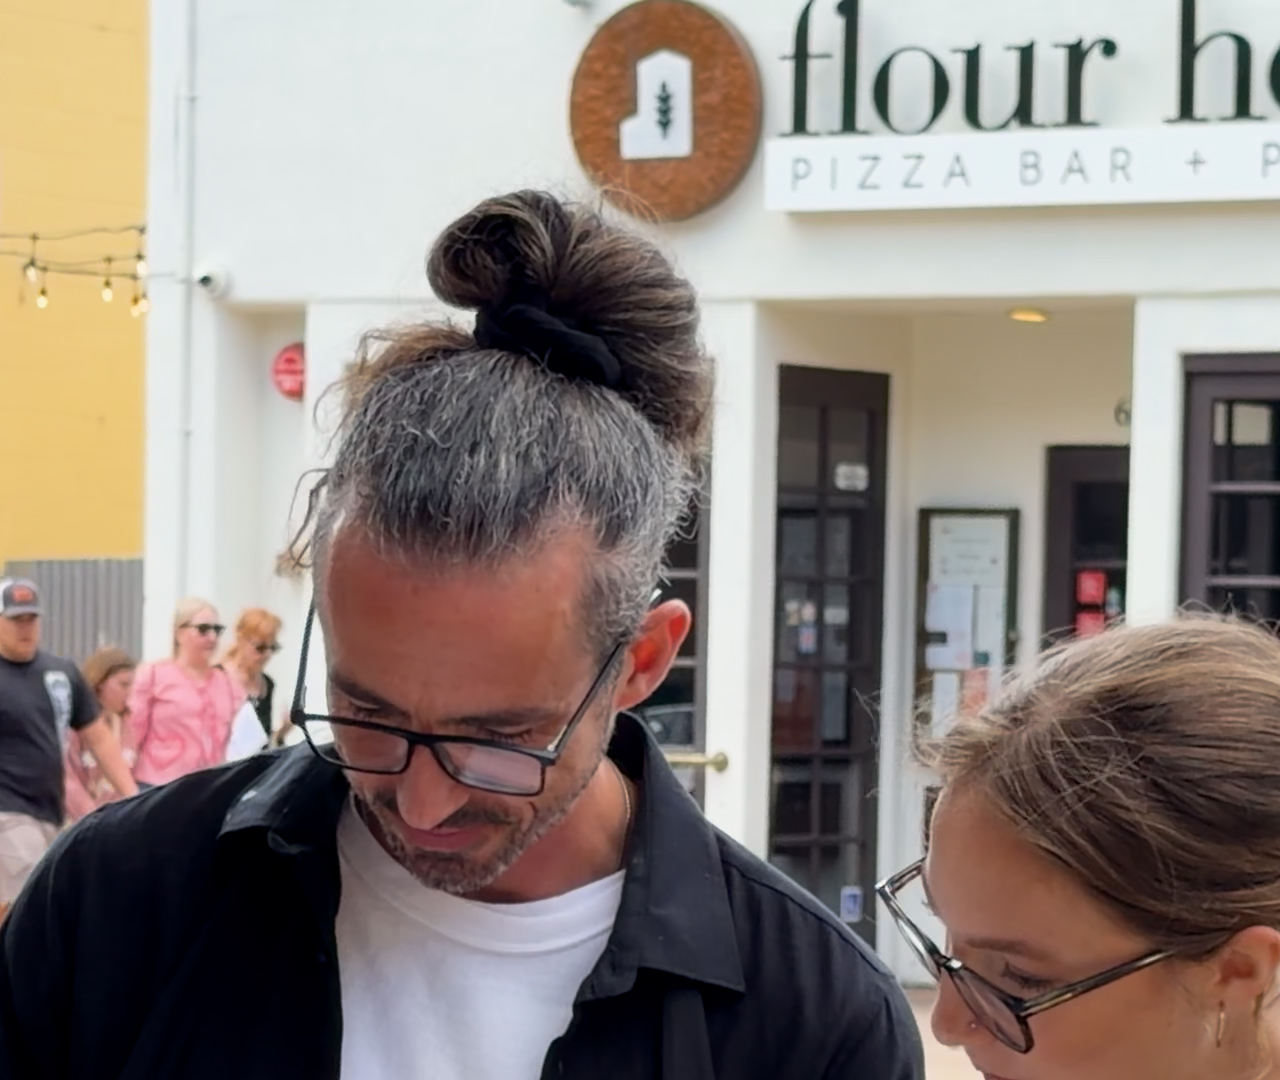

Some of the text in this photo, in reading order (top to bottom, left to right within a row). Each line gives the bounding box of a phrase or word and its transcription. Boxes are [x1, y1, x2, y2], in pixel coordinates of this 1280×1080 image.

[779, 0, 1118, 137] flour
[791, 150, 972, 192] PIZZA
[1021, 147, 1133, 186] BAR
[1185, 150, 1208, 176] +
